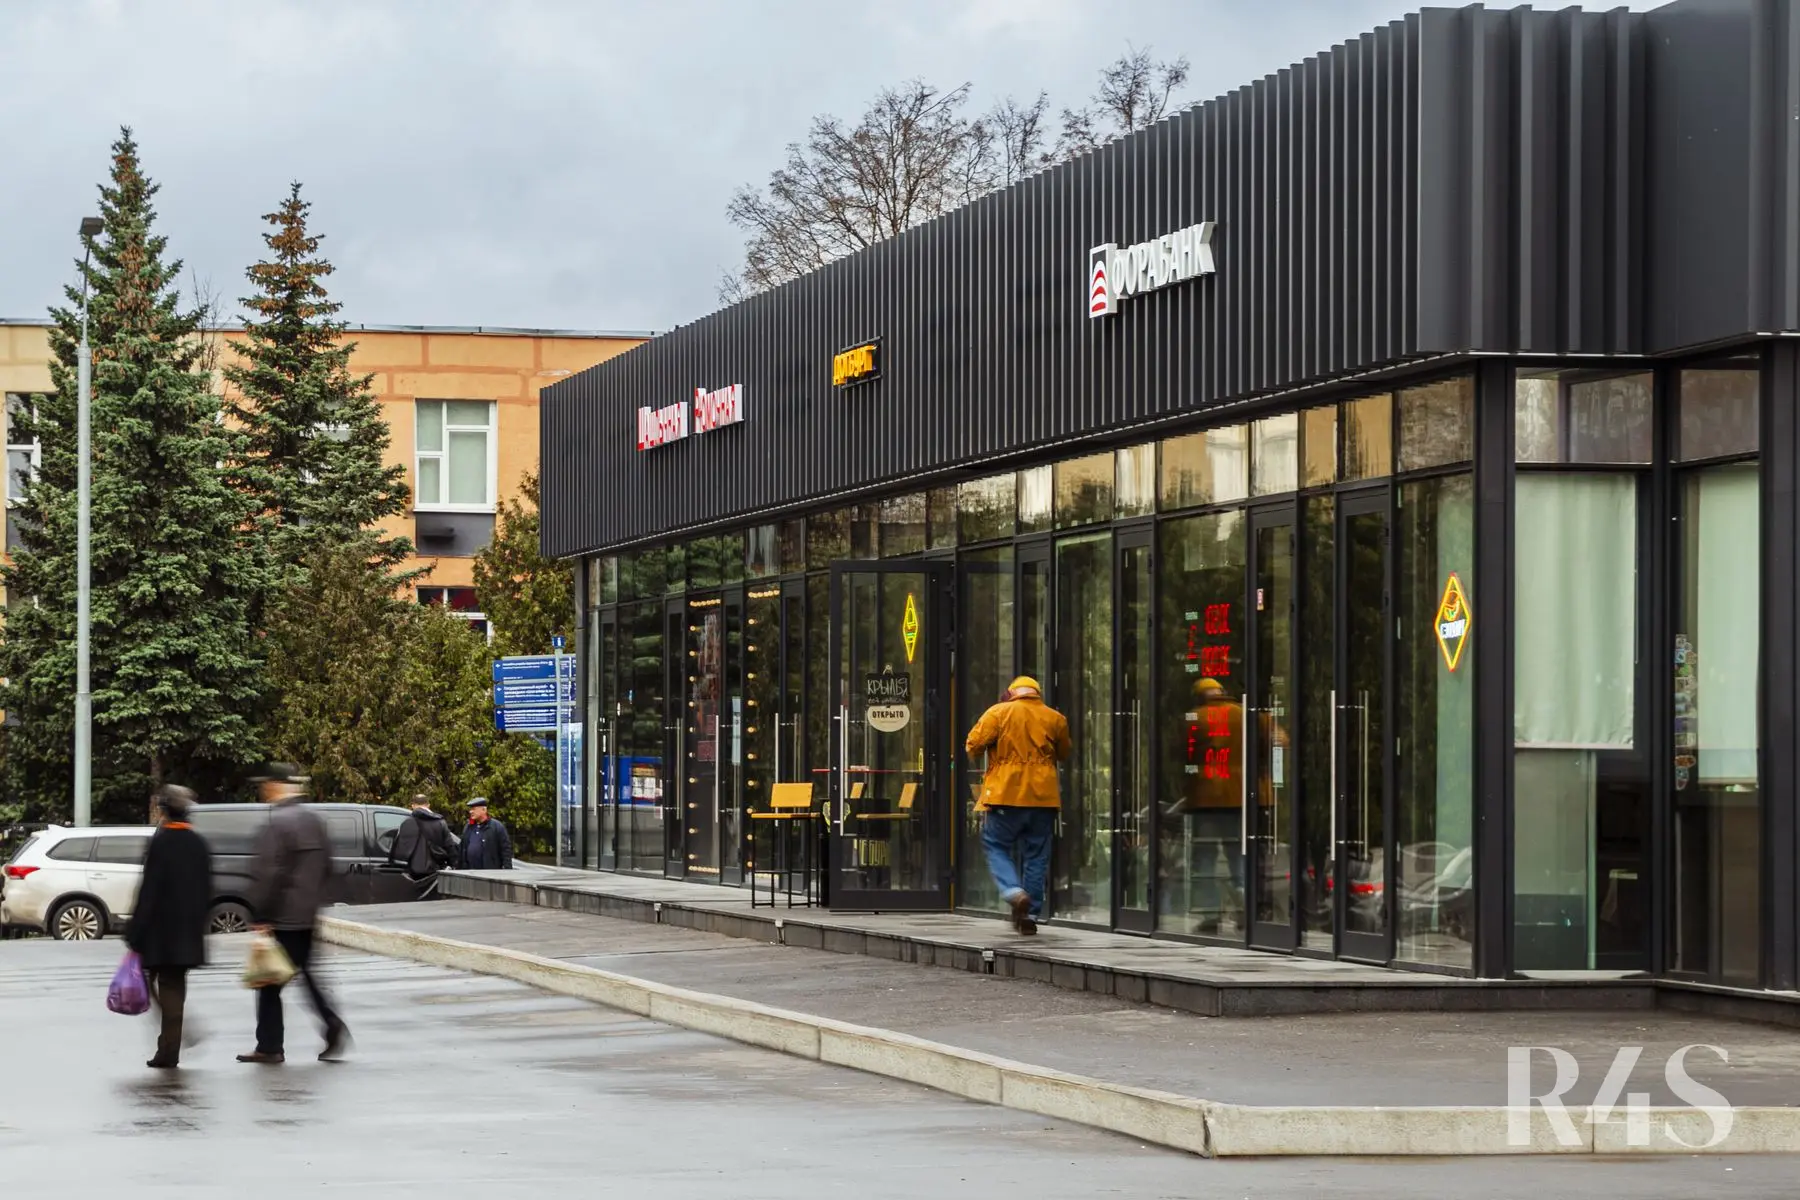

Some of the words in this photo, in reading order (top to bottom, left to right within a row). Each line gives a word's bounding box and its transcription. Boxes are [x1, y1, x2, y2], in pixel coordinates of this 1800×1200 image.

[1112, 222, 1217, 299] ФОРАБАНК
[867, 678, 908, 698] КРЫЛЬЯ
[872, 711, 904, 719] ОТКРЫТО
